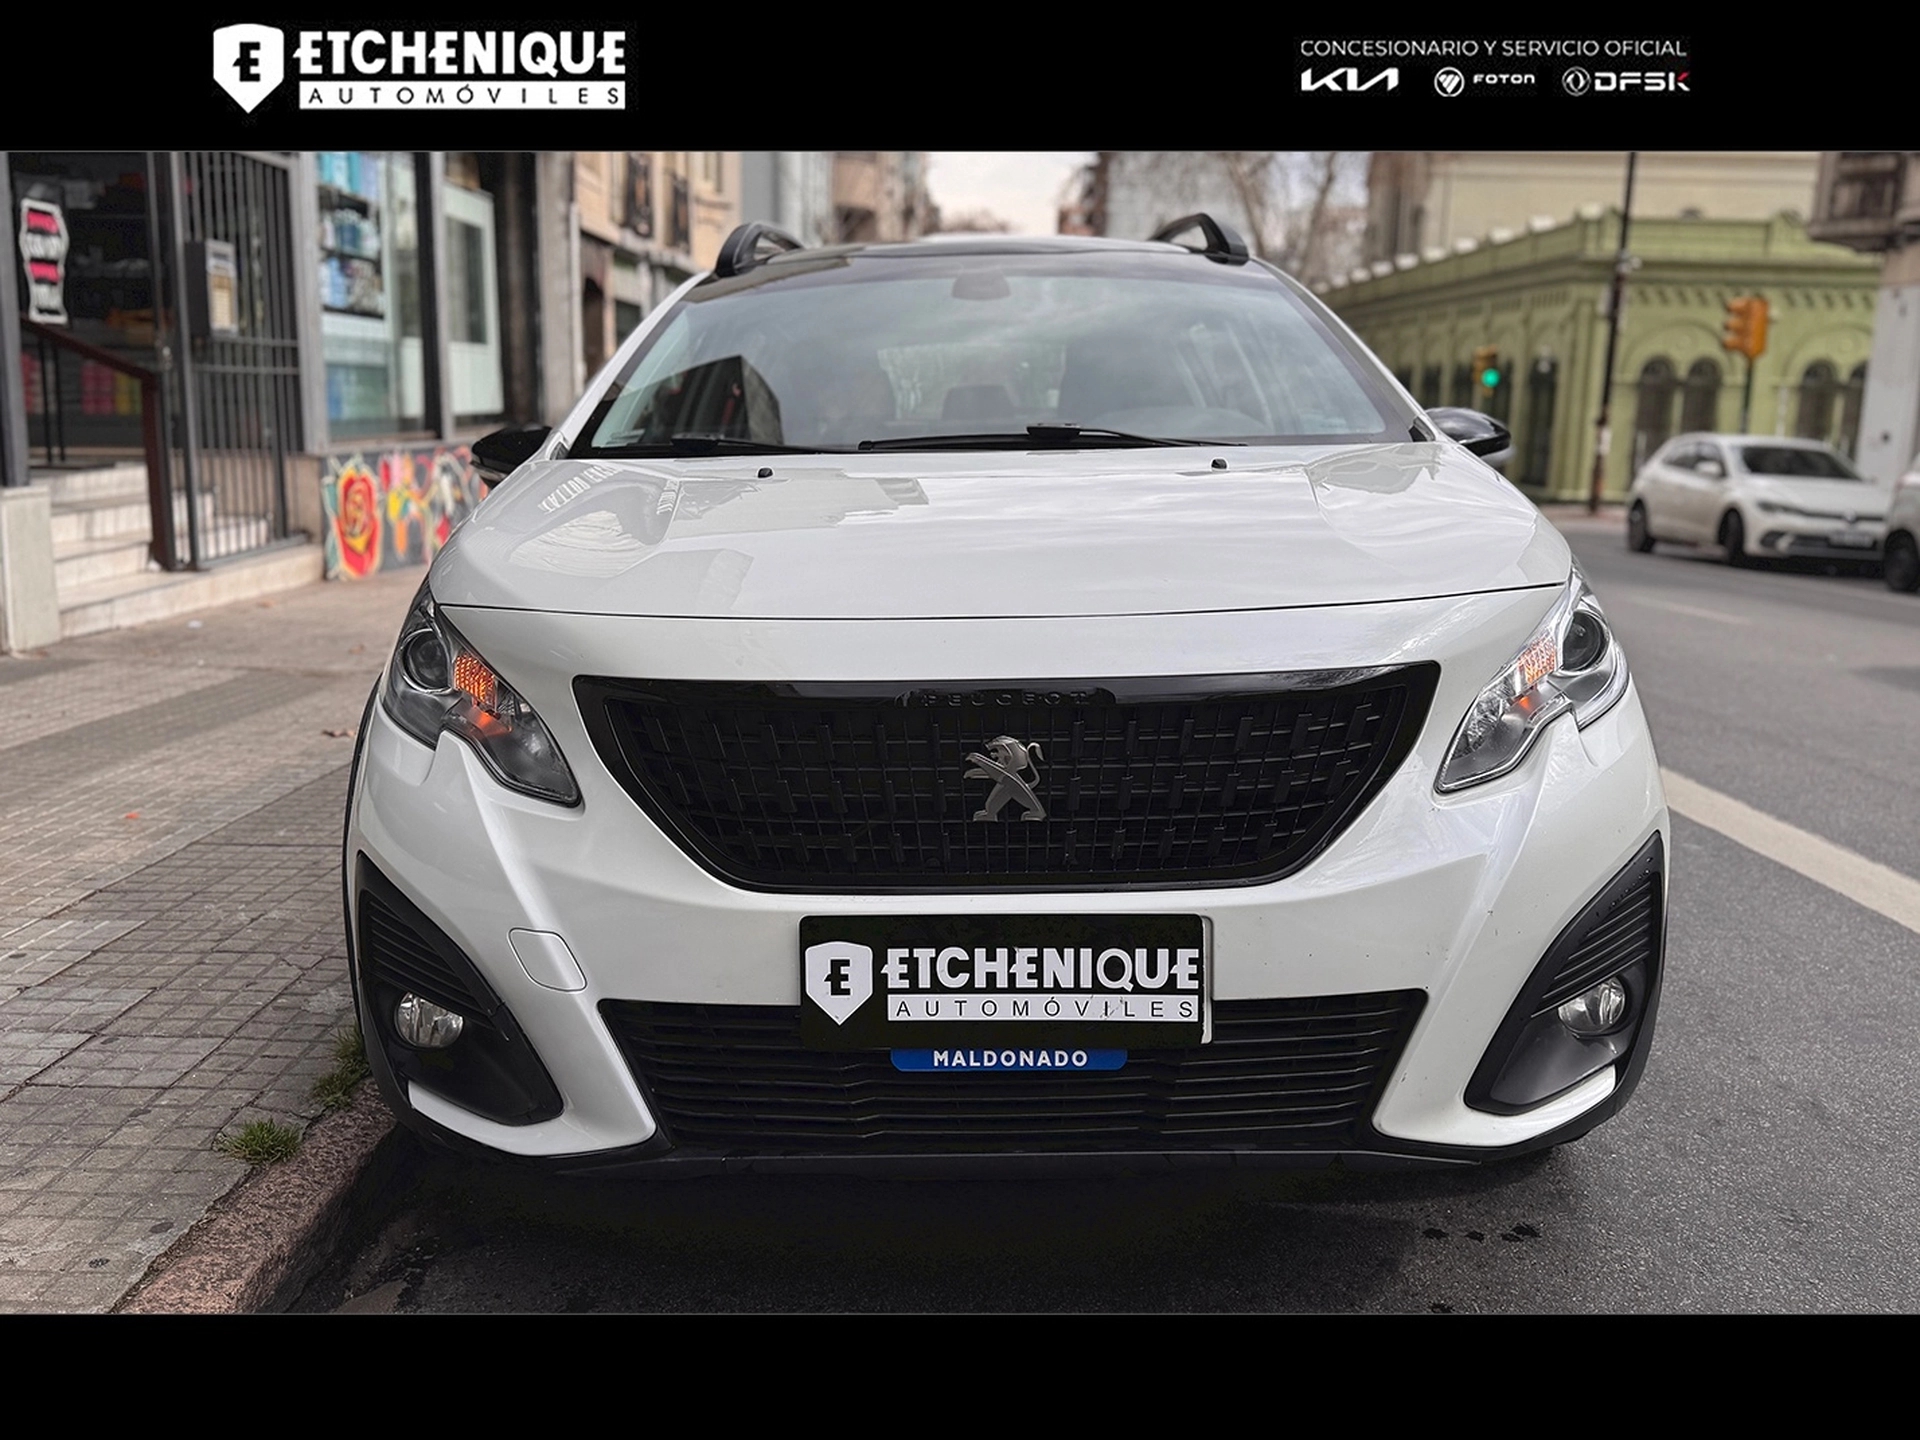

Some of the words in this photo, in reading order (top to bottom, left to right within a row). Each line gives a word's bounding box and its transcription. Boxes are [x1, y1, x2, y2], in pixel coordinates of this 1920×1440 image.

[881, 947, 1199, 992] ETCHENIQUE
[896, 997, 1193, 1018] AUTOMÓVILES
[932, 1050, 1088, 1068] MALDONADO
